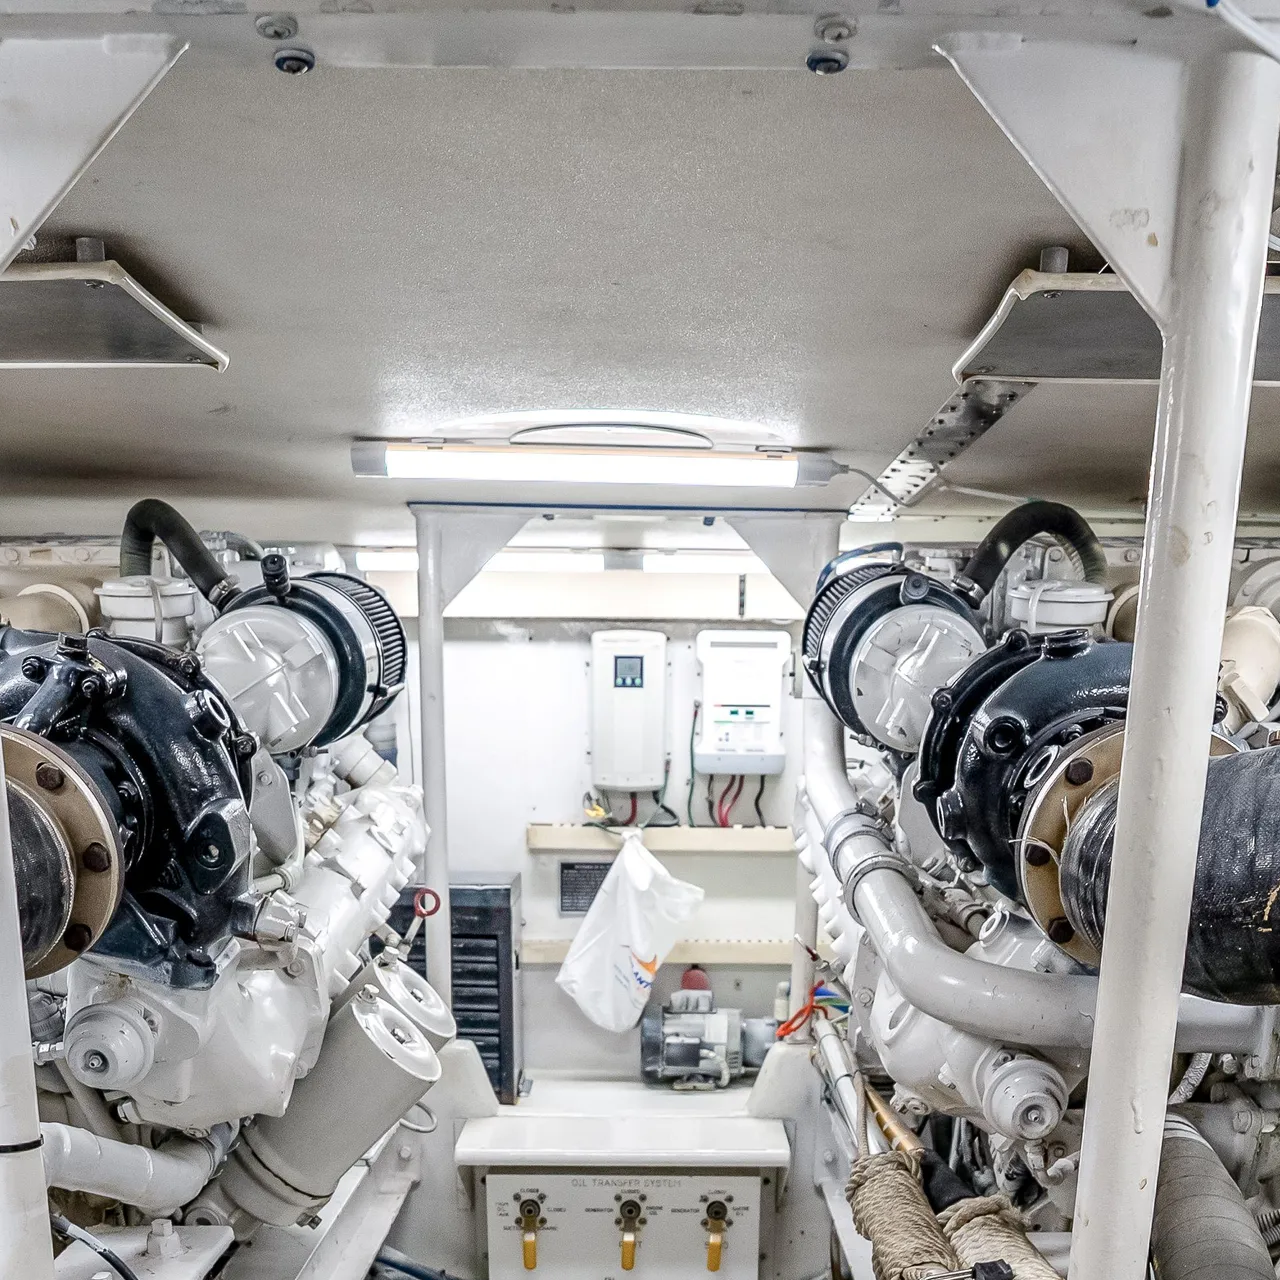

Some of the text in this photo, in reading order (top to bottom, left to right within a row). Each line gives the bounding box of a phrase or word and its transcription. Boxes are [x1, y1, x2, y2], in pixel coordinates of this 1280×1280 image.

[571, 1178, 681, 1188] OIL TRANSFER SYSTEM
